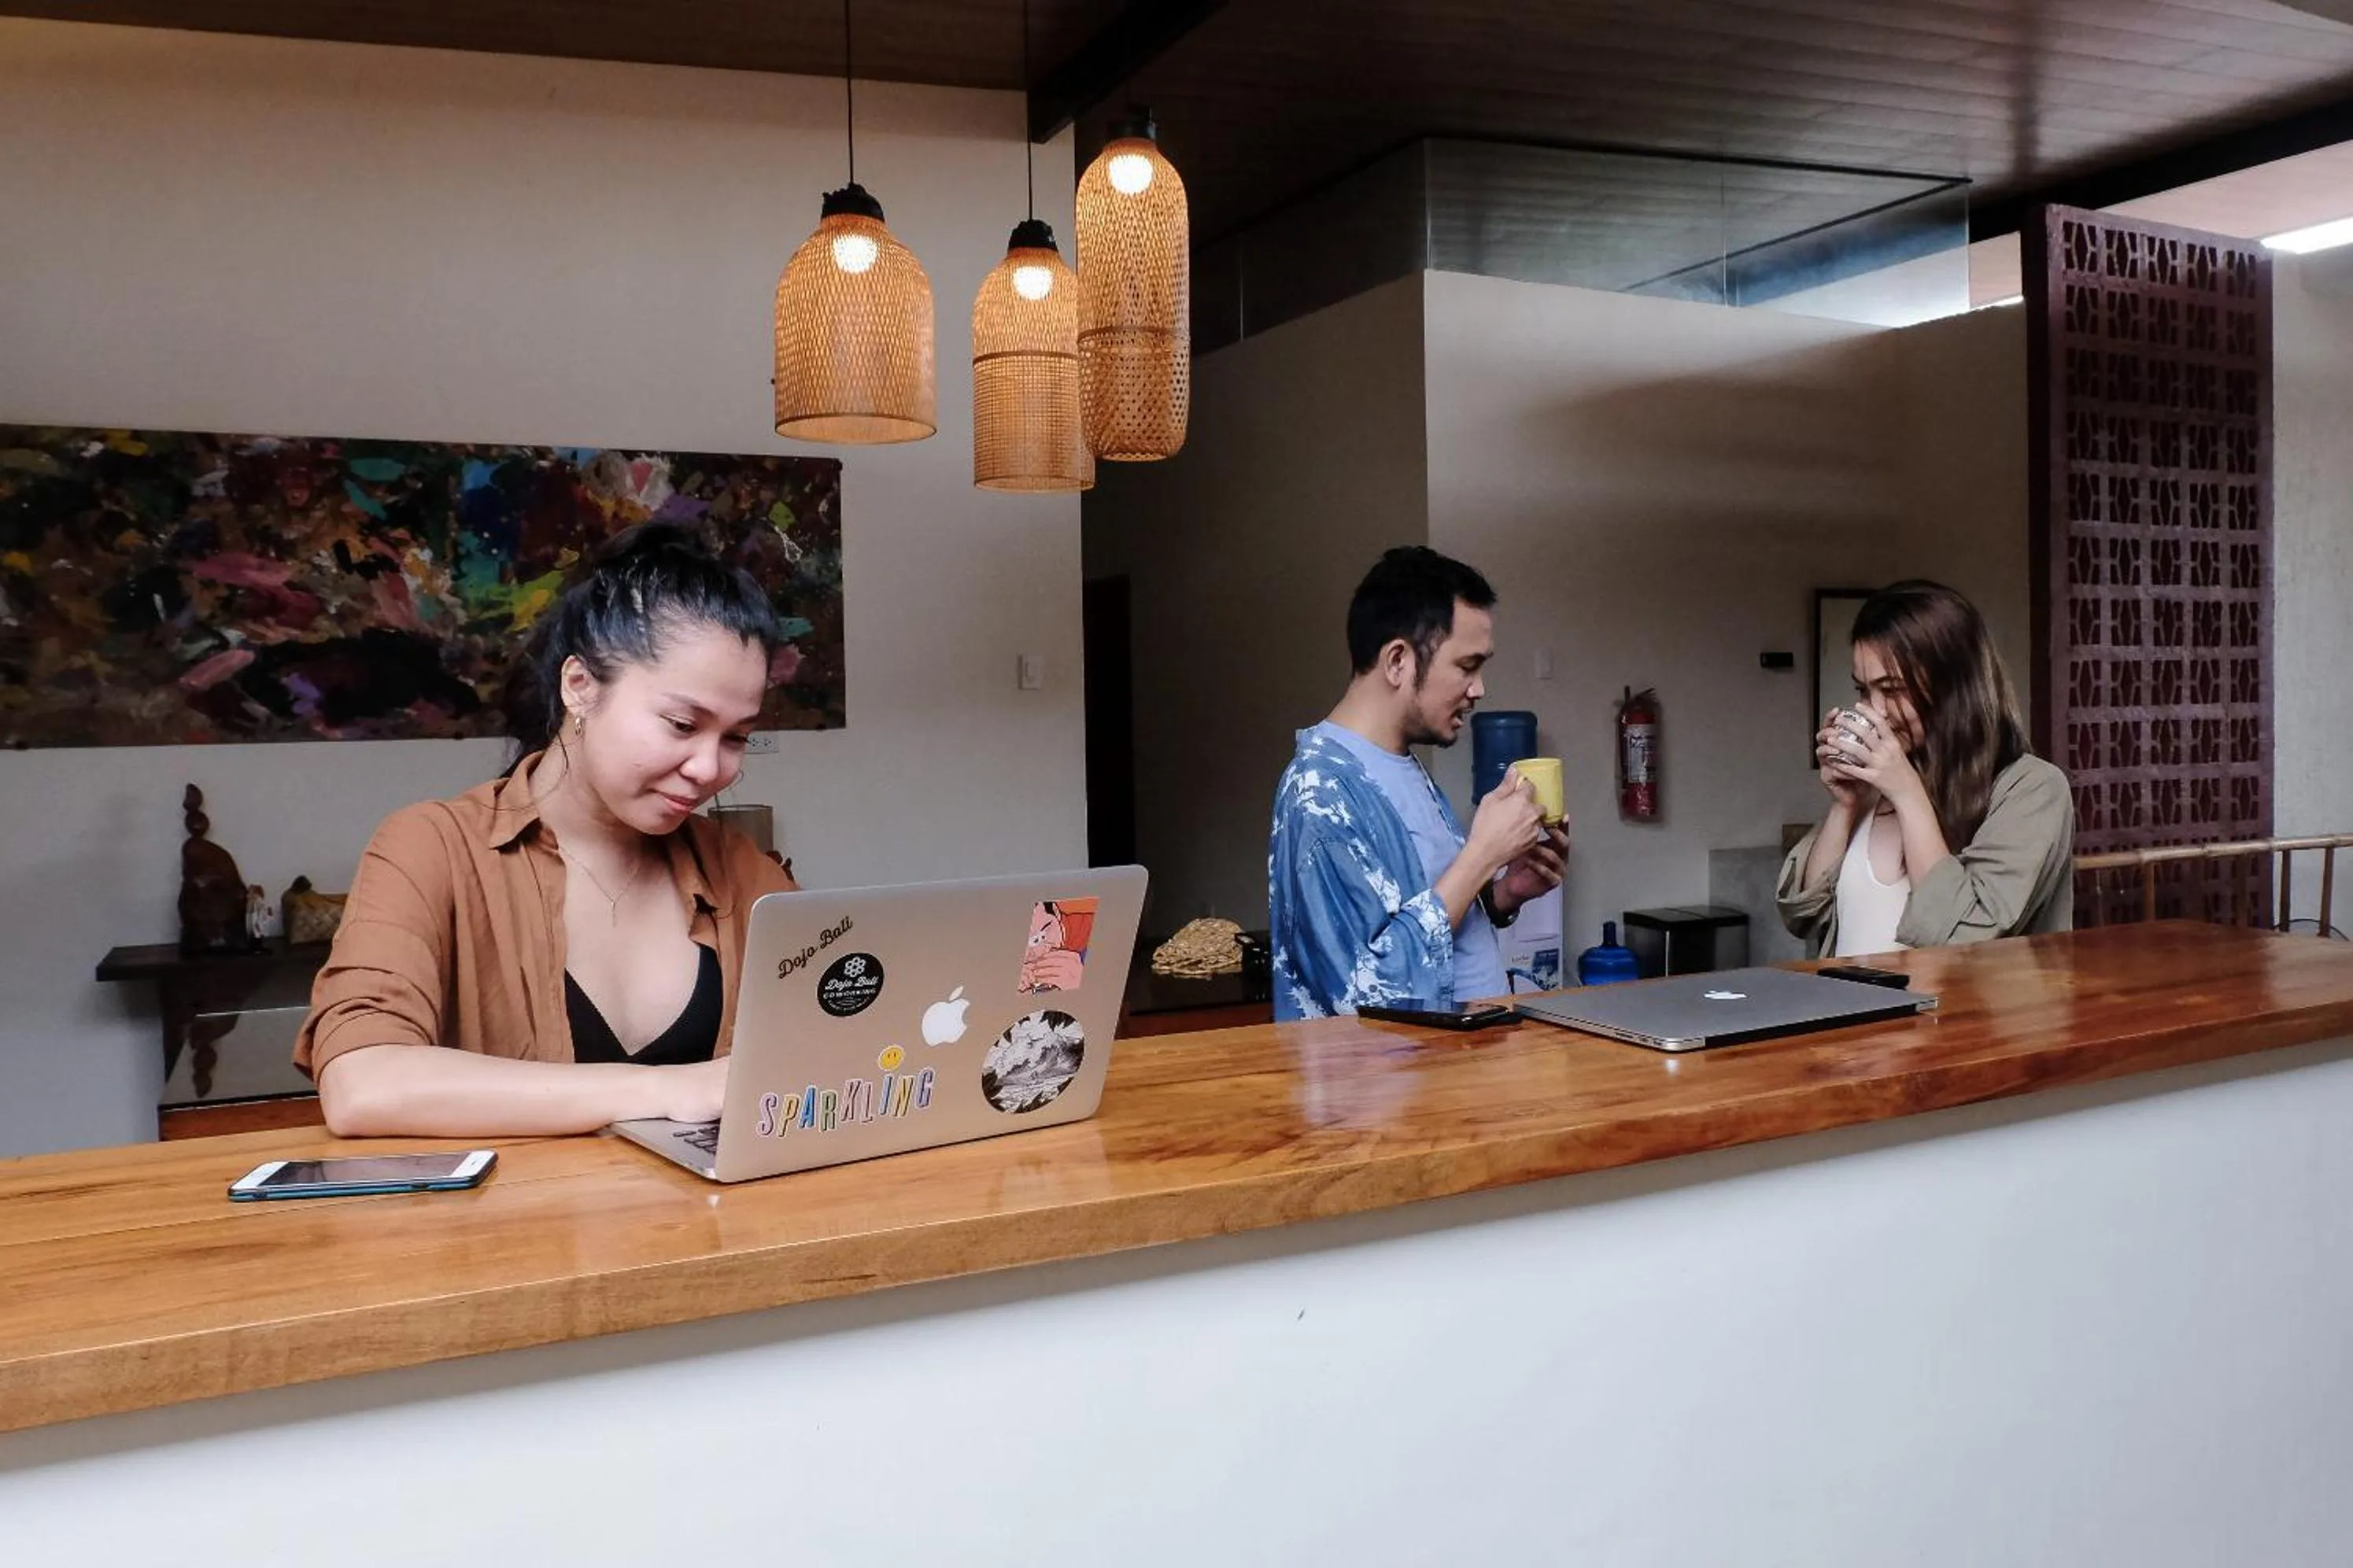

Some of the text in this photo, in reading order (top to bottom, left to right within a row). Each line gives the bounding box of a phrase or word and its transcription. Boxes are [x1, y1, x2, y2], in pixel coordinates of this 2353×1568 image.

[778, 915, 853, 979] Dojo Bali
[825, 978, 852, 991] Dojo
[757, 1066, 936, 1138] SPARKLING
